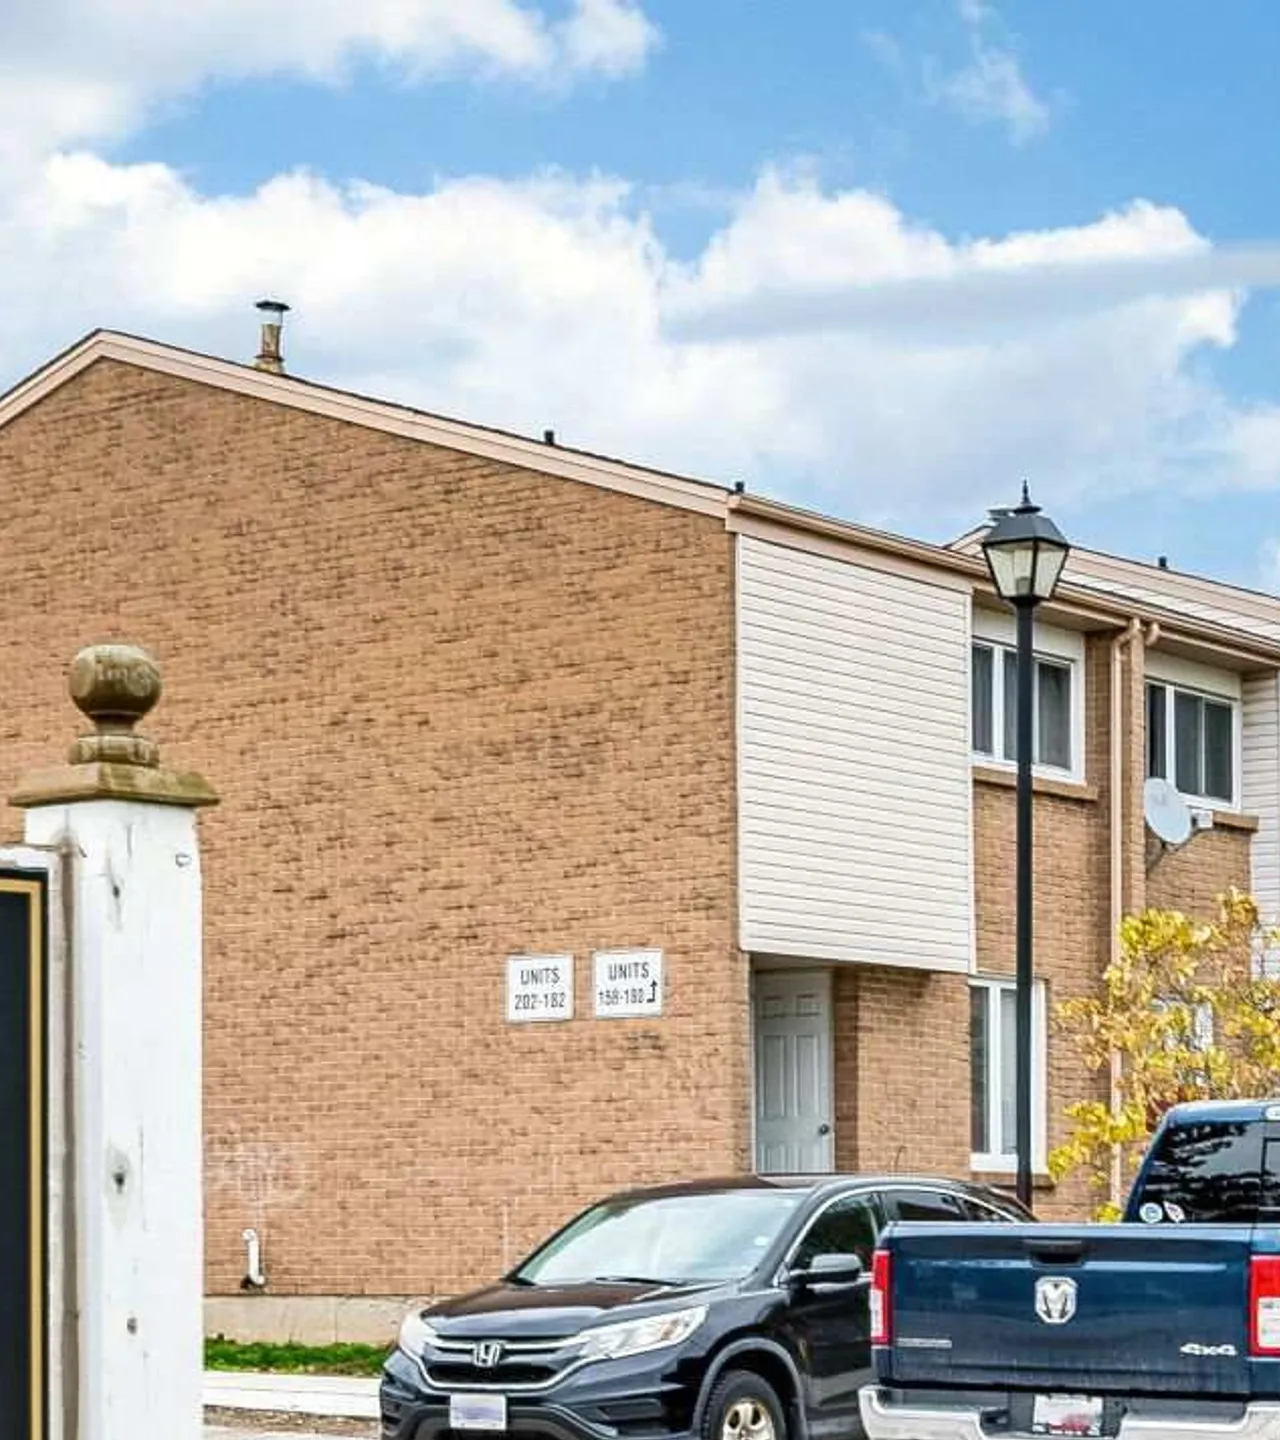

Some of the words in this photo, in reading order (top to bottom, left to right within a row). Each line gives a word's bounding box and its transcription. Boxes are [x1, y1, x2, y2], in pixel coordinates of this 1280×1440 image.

[520, 966, 559, 985] UNITS
[608, 962, 649, 981] UNITS
[515, 992, 566, 1010] 202-182
